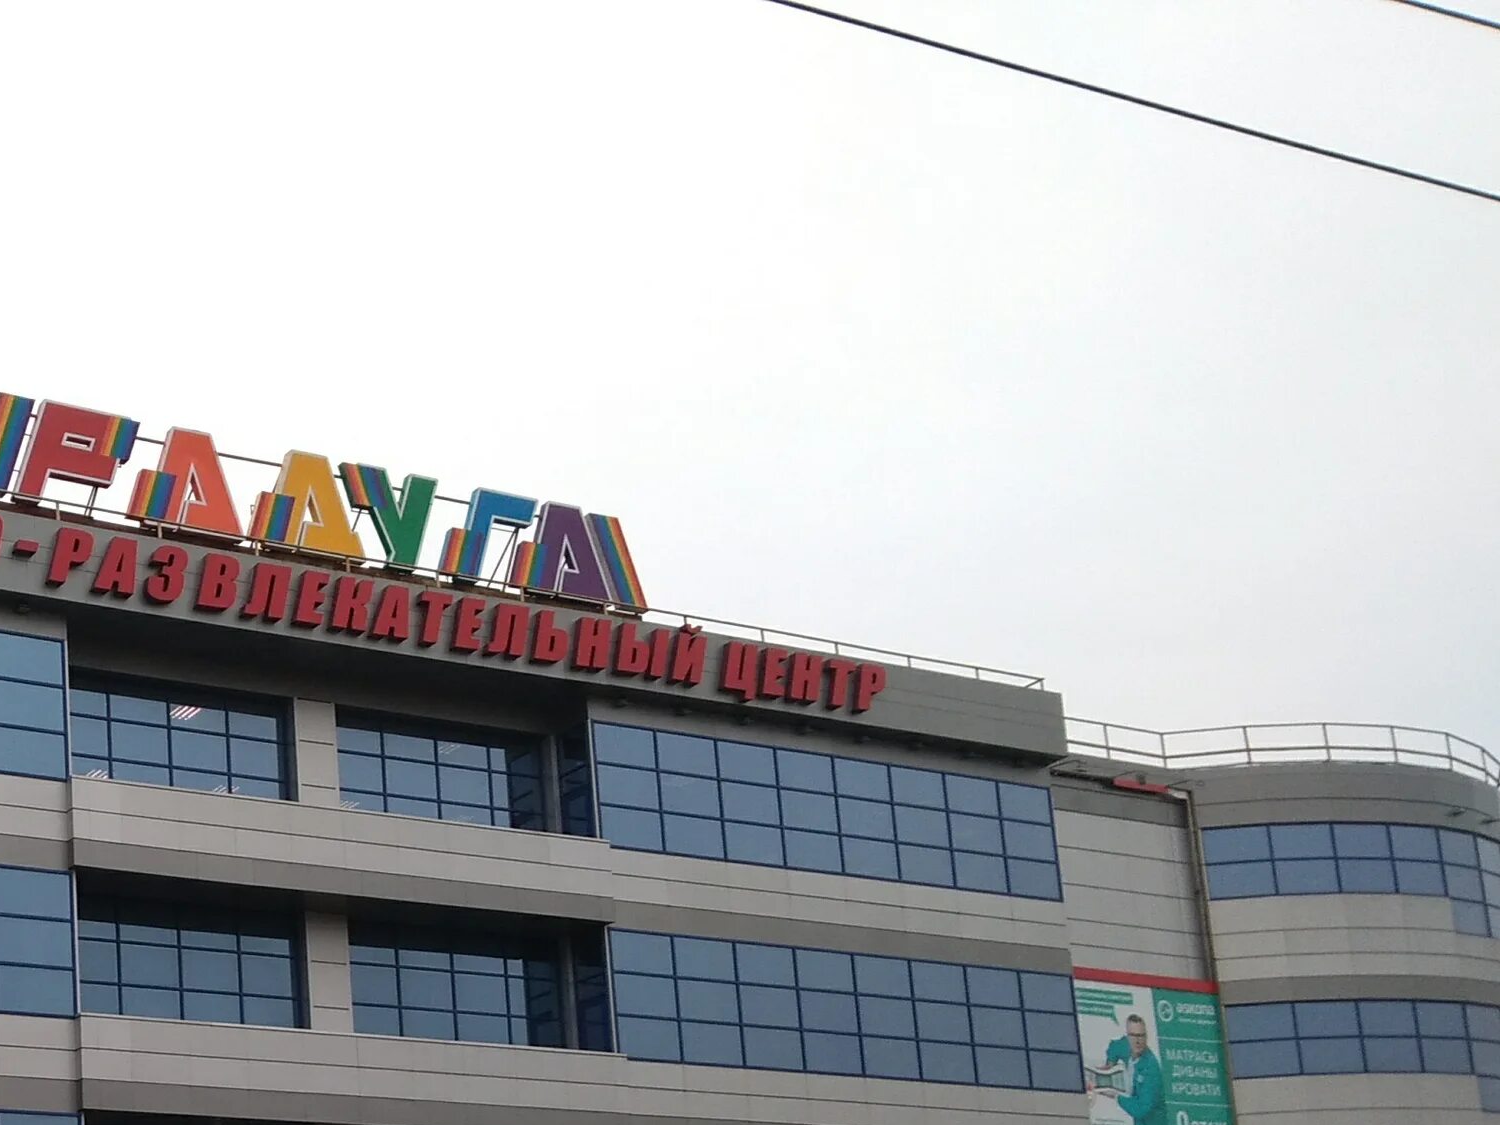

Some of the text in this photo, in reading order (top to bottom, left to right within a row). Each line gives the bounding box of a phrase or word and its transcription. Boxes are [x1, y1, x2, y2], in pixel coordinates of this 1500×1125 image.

[719, 640, 888, 713] ЦЕНТР
[1166, 1049, 1218, 1063] МАТРАСЫ
[1172, 1065, 1217, 1078] ДИВАНЫ
[1171, 1083, 1221, 1096] КРОВАТИ
